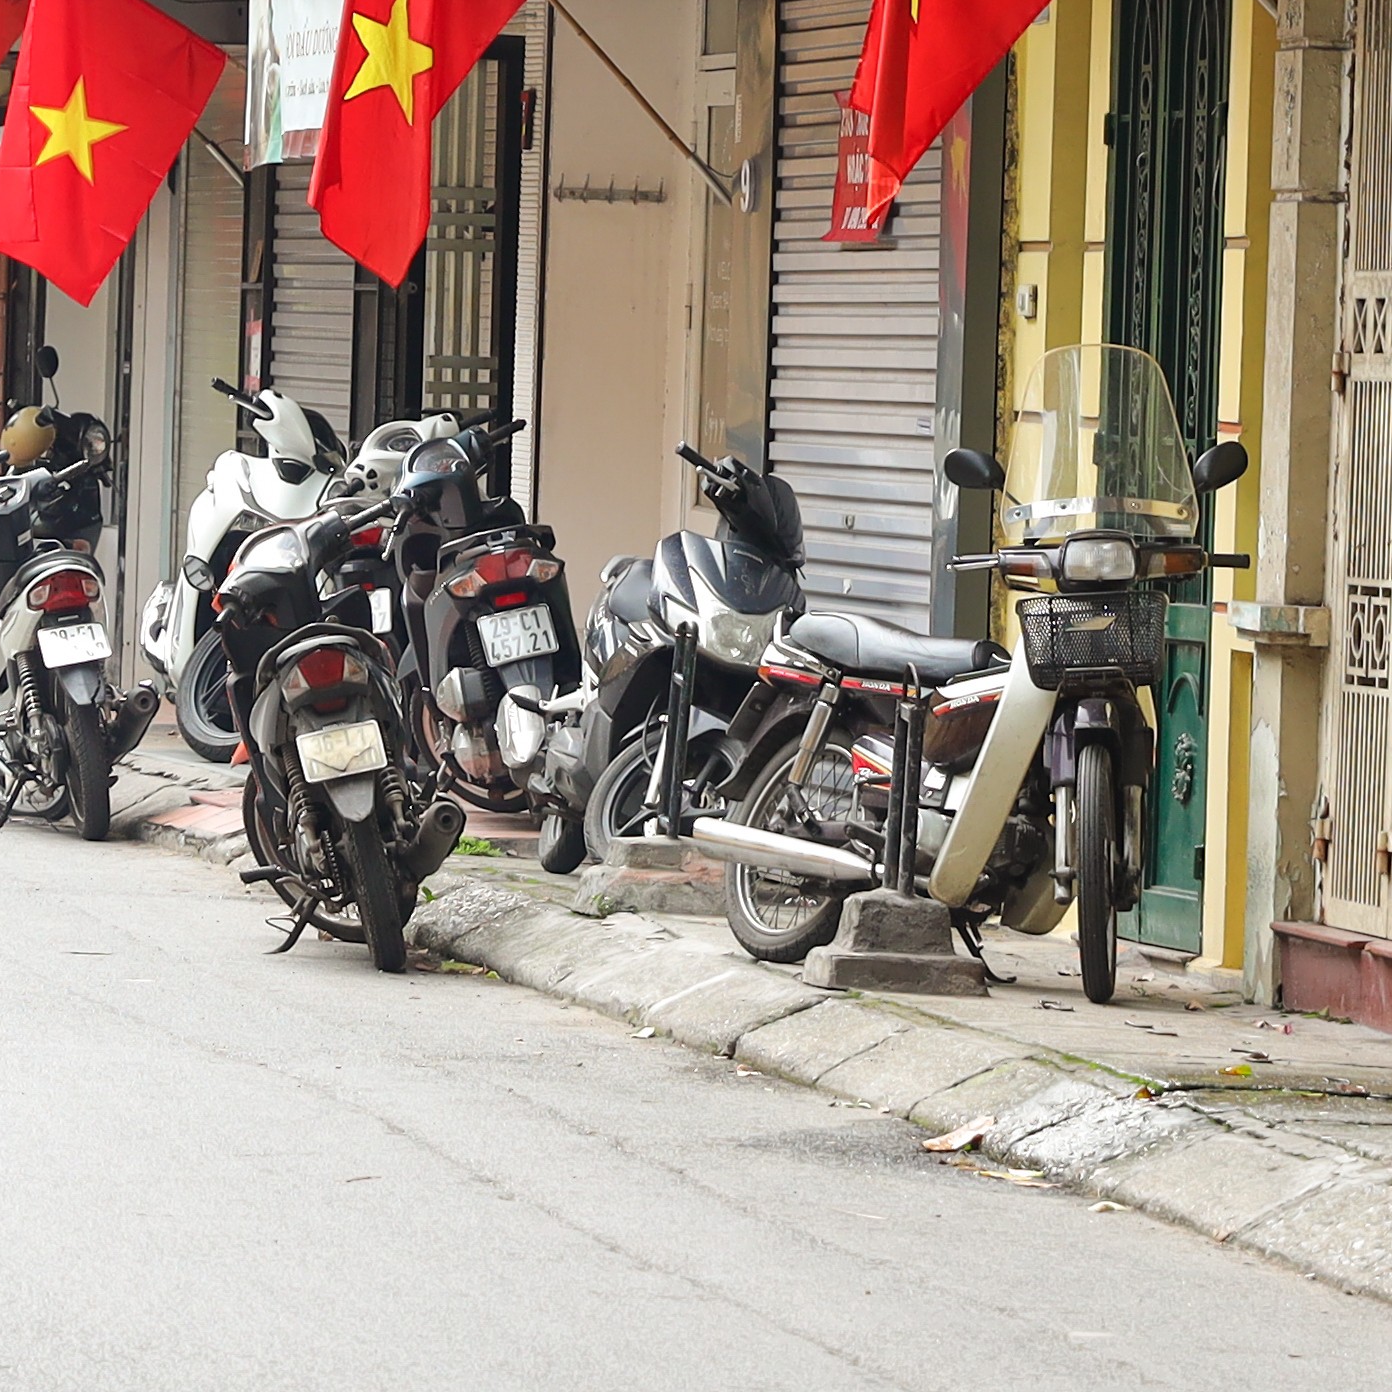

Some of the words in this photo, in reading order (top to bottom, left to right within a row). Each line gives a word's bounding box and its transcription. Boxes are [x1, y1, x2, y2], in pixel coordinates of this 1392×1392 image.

[740, 158, 752, 213] 9
[489, 609, 541, 639] 29-C1
[491, 630, 552, 661] 457.21
[861, 681, 891, 692] HONDA
[950, 696, 980, 709] HONDA
